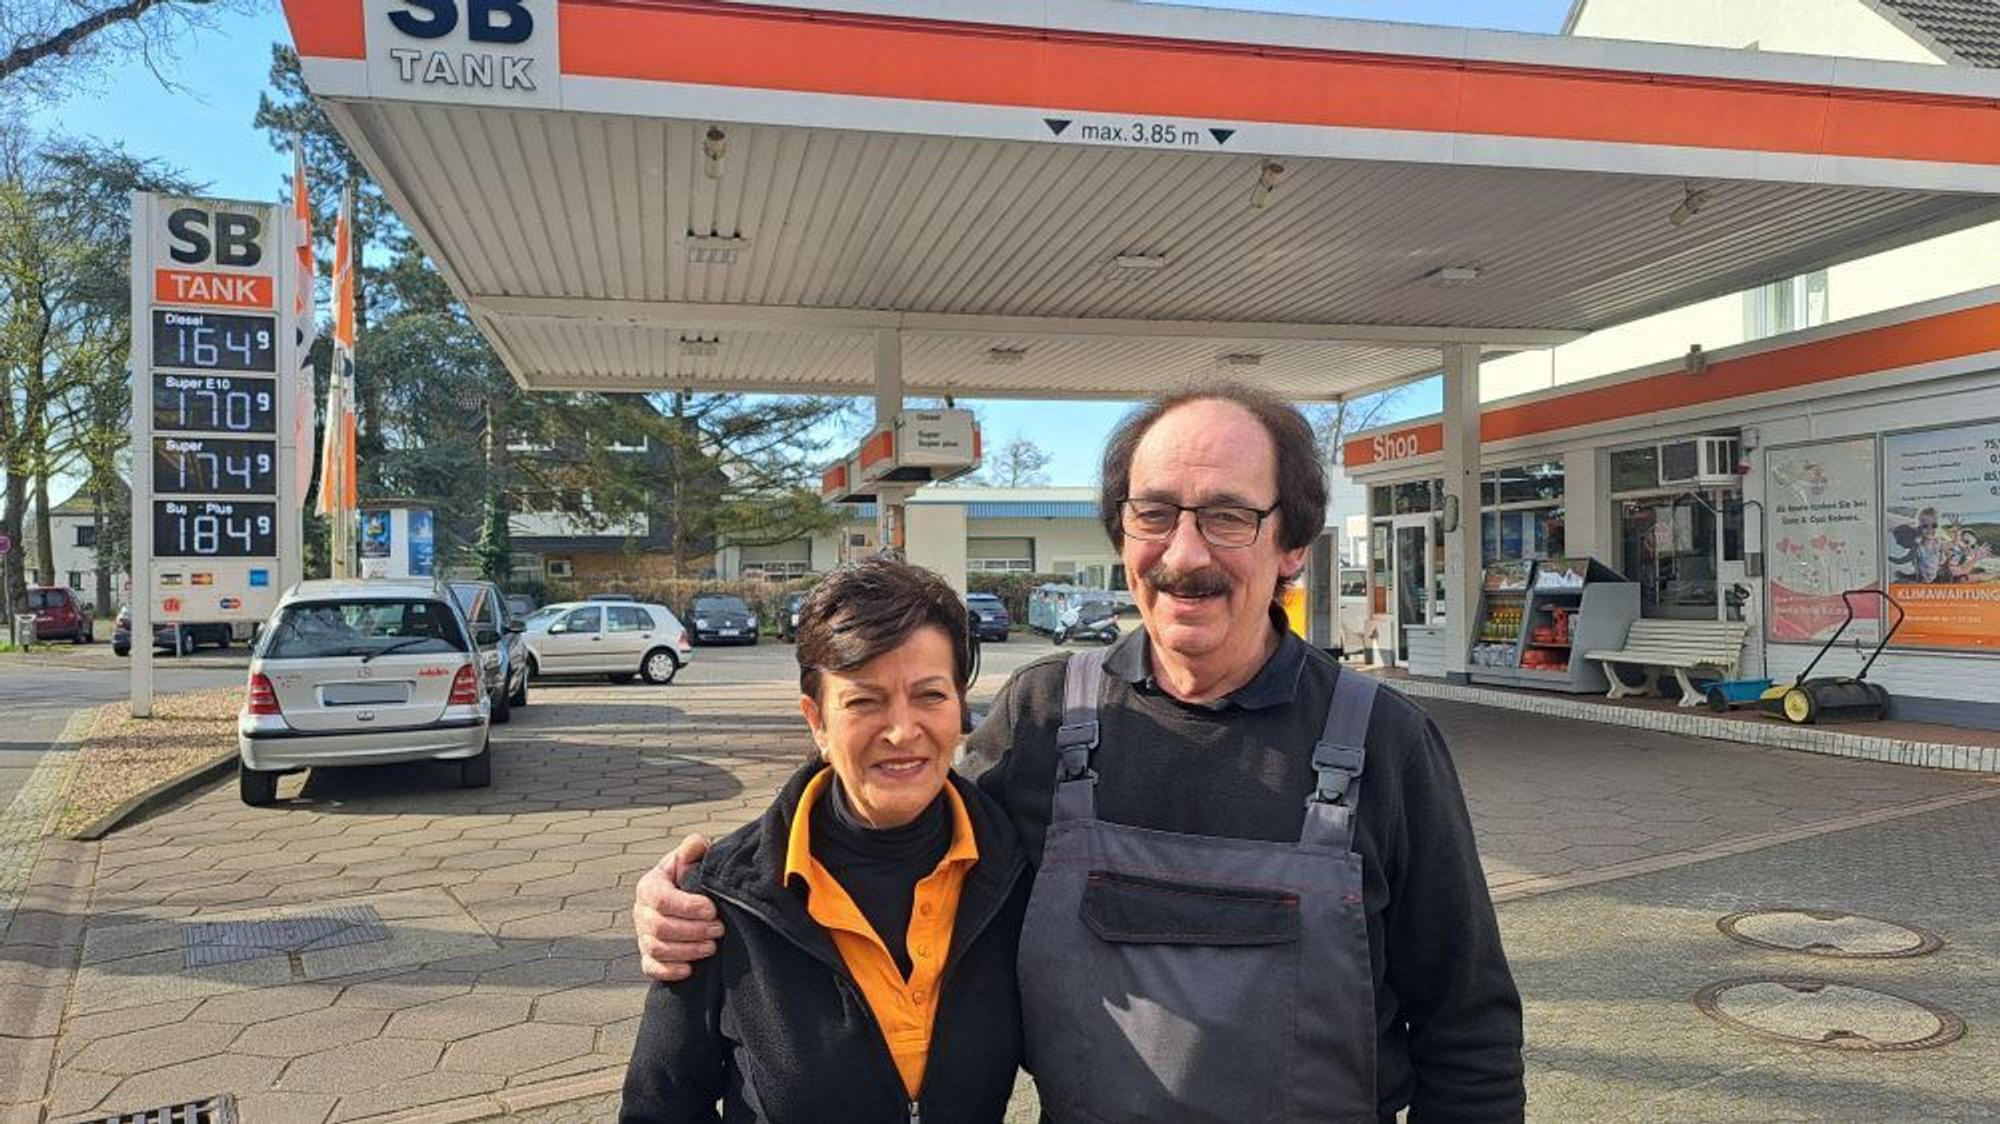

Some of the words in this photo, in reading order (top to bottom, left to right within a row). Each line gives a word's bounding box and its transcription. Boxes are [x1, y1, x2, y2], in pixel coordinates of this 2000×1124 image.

[390, 48, 536, 90] TANK
[1082, 125, 1127, 141] max.
[1182, 131, 1199, 145] m
[168, 208, 261, 267] SB
[170, 274, 258, 302] TANK
[165, 313, 204, 325] Diesel
[165, 376, 203, 391] Super
[206, 378, 231, 389] E10
[165, 440, 203, 452] Super
[1374, 433, 1418, 461] Shop
[206, 503, 233, 515] Plus
